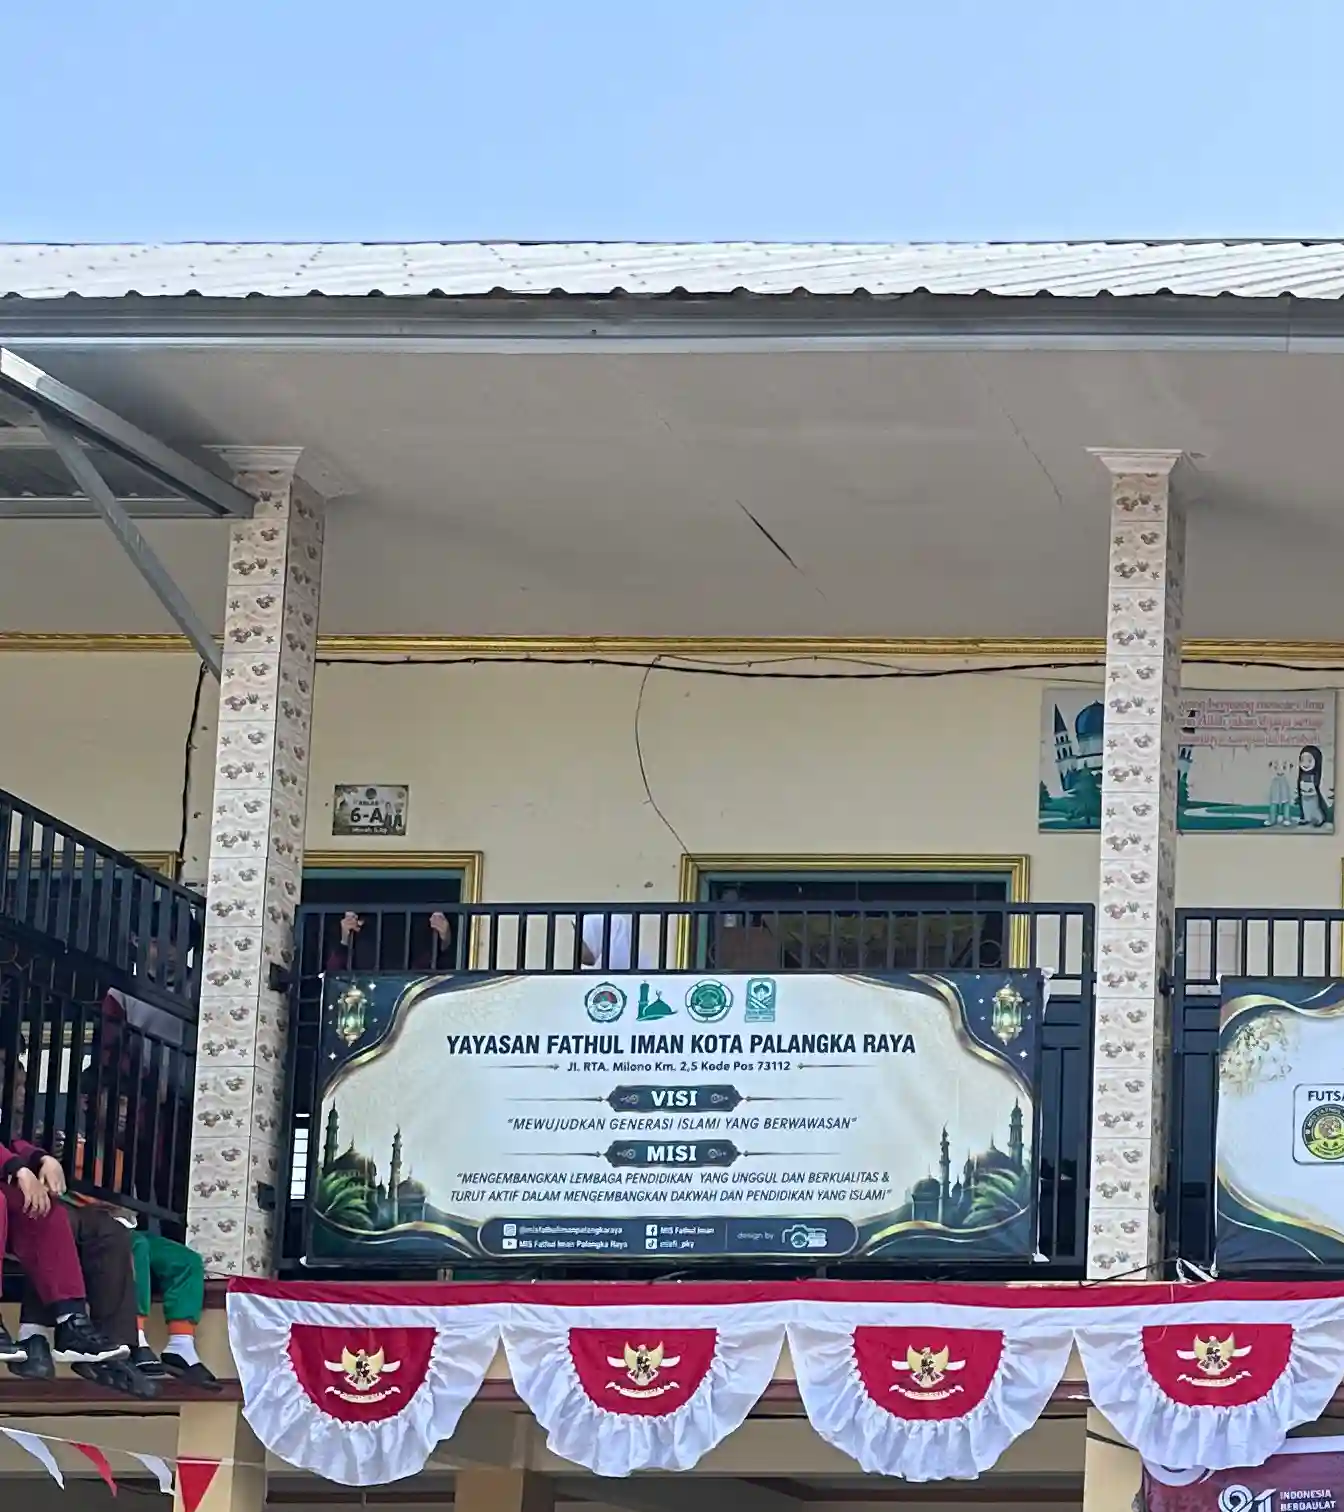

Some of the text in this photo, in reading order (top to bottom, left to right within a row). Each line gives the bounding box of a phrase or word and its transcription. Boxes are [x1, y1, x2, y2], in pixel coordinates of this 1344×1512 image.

[351, 807, 383, 823] 6-A
[446, 1033, 916, 1055] YAYASAN FATHUL IMAN KOTA PALANGKA RAYA
[583, 1061, 610, 1072] RTA.
[612, 1061, 652, 1072] Milono
[654, 1061, 677, 1072] Km.
[700, 1060, 731, 1072] Kode
[733, 1061, 754, 1071] Pos
[757, 1060, 791, 1071] 73112
[650, 1090, 698, 1107] VISI
[609, 1117, 674, 1131] GENERASI
[677, 1117, 721, 1130] ISLAMI
[725, 1117, 760, 1130] YANG
[646, 1146, 697, 1163] MISI
[569, 1172, 623, 1185] LEMBAGA
[624, 1172, 694, 1185] PENDIDIKAN
[700, 1171, 730, 1184] YANG
[731, 1171, 778, 1184] UNGGUL
[780, 1171, 806, 1184] DAN
[807, 1171, 880, 1184] BERKUALITAS
[450, 1189, 487, 1202] TURUT
[487, 1189, 520, 1202] AKTIF
[521, 1190, 562, 1202] DALAM
[563, 1190, 669, 1203] MENGEMBANGKAN
[670, 1189, 718, 1202] DAKWAH
[719, 1189, 744, 1202] DAN
[745, 1189, 815, 1202] PENDIDIKAN
[817, 1189, 847, 1201] YANG
[1280, 1489, 1332, 1500] INDONESIA
[1280, 1500, 1337, 1512] BERDAULAT
